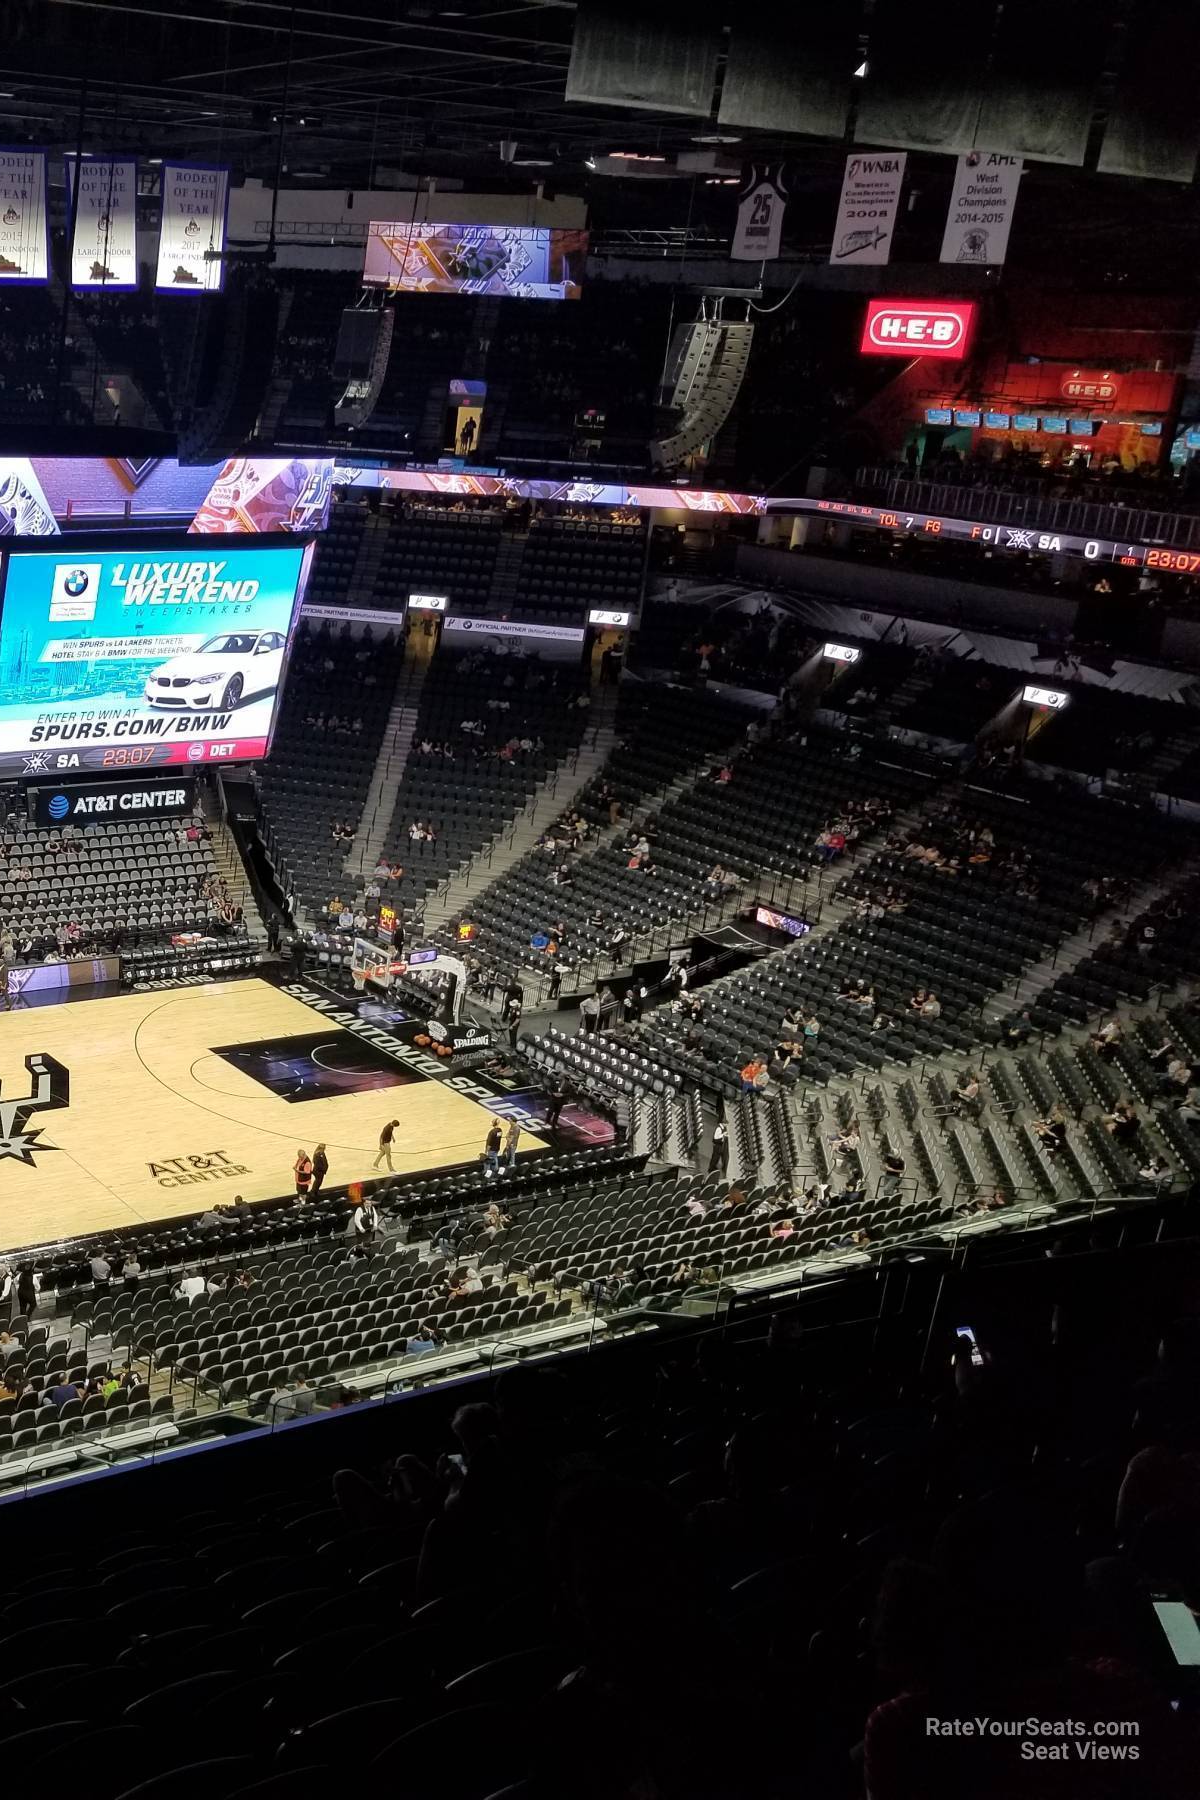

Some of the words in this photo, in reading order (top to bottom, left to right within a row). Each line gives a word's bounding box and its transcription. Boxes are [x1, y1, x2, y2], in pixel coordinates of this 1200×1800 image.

[986, 153, 1017, 166] AHL
[862, 160, 900, 174] WNBA
[8, 173, 36, 184] THE
[176, 172, 218, 184] RODEO
[976, 173, 999, 183] West
[81, 182, 98, 192] OF
[101, 182, 127, 193] THE
[173, 187, 191, 198] OF
[193, 188, 217, 200] THE
[966, 185, 1003, 195] Division
[180, 203, 210, 215] YEAR
[749, 193, 773, 225] 25
[958, 197, 1007, 208] Champions
[846, 210, 888, 218] 2008
[954, 213, 1005, 224] 2014-2015
[77, 248, 102, 257] LARGE
[103, 248, 132, 257] NDOOR
[181, 241, 201, 251] 2017
[879, 512, 899, 527] TOL
[905, 516, 914, 529] 7
[925, 520, 941, 533] FG
[971, 526, 980, 538] F
[982, 528, 992, 540] 0
[1038, 535, 1061, 552] SA
[1084, 541, 1100, 559] 0
[1127, 546, 1135, 557] 1
[1146, 550, 1200, 572] 23:07
[111, 561, 227, 587] LUXURY
[122, 580, 260, 607] WEEKEND
[122, 604, 253, 617] SWEEPSTAKES
[475, 623, 500, 631] OFFICIAL
[500, 624, 527, 633] PARTNER
[62, 641, 78, 650] WIN
[78, 639, 105, 649] SPURS
[113, 638, 124, 647] LA
[124, 637, 153, 647] LAKERS
[51, 650, 75, 660] HOTEL
[76, 650, 95, 658] STAY
[107, 648, 127, 657] BMW
[128, 648, 143, 656] FOR
[143, 647, 157, 655] THE
[37, 712, 78, 725] ENTER
[80, 710, 96, 721] TO
[98, 709, 123, 720] WIN
[123, 708, 140, 719] AT
[29, 714, 233, 743] SPURS.COM/BMW
[56, 753, 80, 769] SA
[102, 747, 155, 767] 23:07
[209, 743, 236, 758] DET
[73, 793, 118, 815] AT&T
[119, 789, 186, 810] CENTER
[133, 974, 216, 990] @SPURS
[453, 1034, 489, 1050] SPALDING
[279, 983, 339, 1011] SAN
[325, 1010, 450, 1074] ANTONIO
[443, 1076, 552, 1133] SPURS
[144, 1149, 233, 1178] AT&T
[157, 1164, 254, 1188] CENTER
